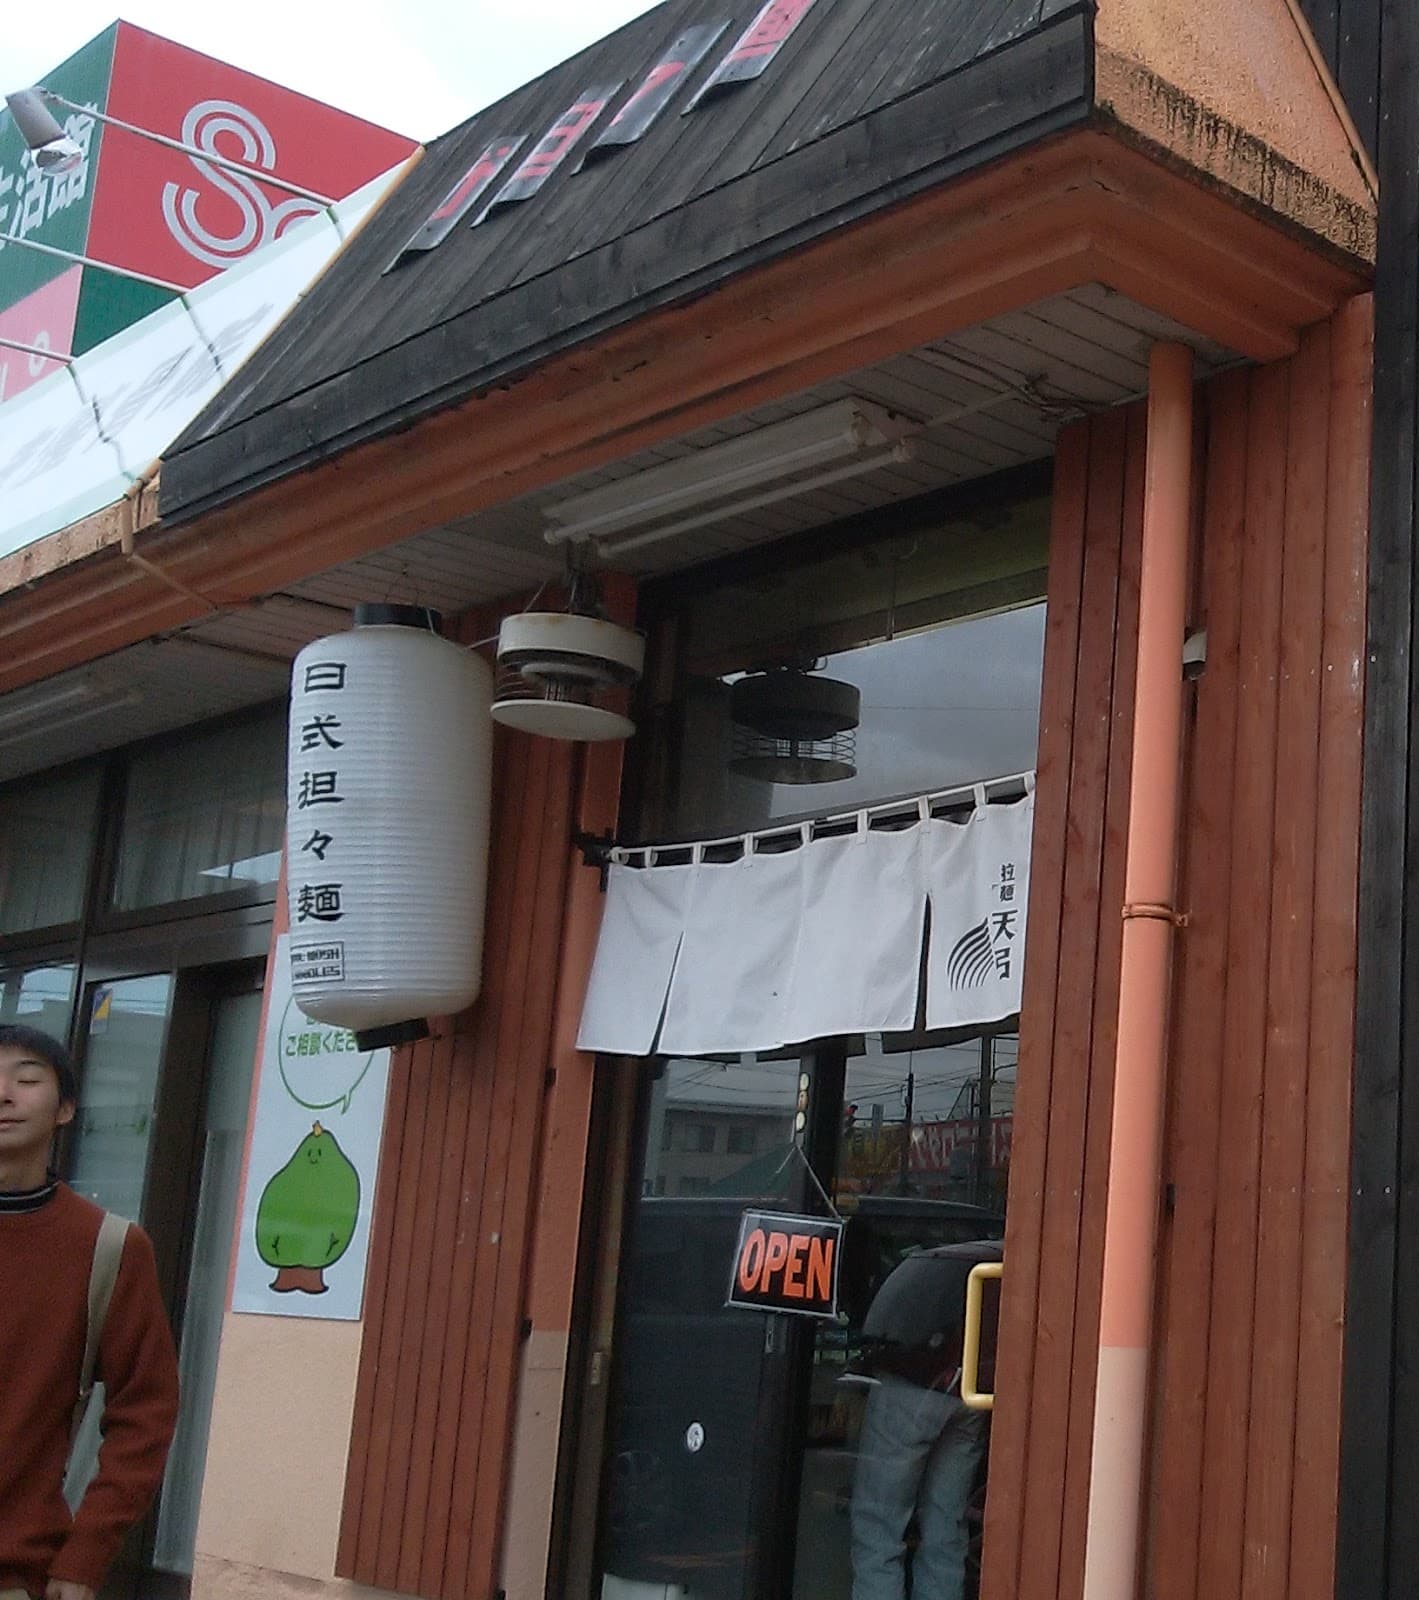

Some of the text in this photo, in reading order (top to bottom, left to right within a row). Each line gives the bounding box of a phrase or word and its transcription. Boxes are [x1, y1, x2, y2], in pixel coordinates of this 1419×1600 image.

[991, 910, 1018, 980] 天弓
[286, 1030, 357, 1056] ご相談くださ
[740, 1228, 834, 1301] OPEN
